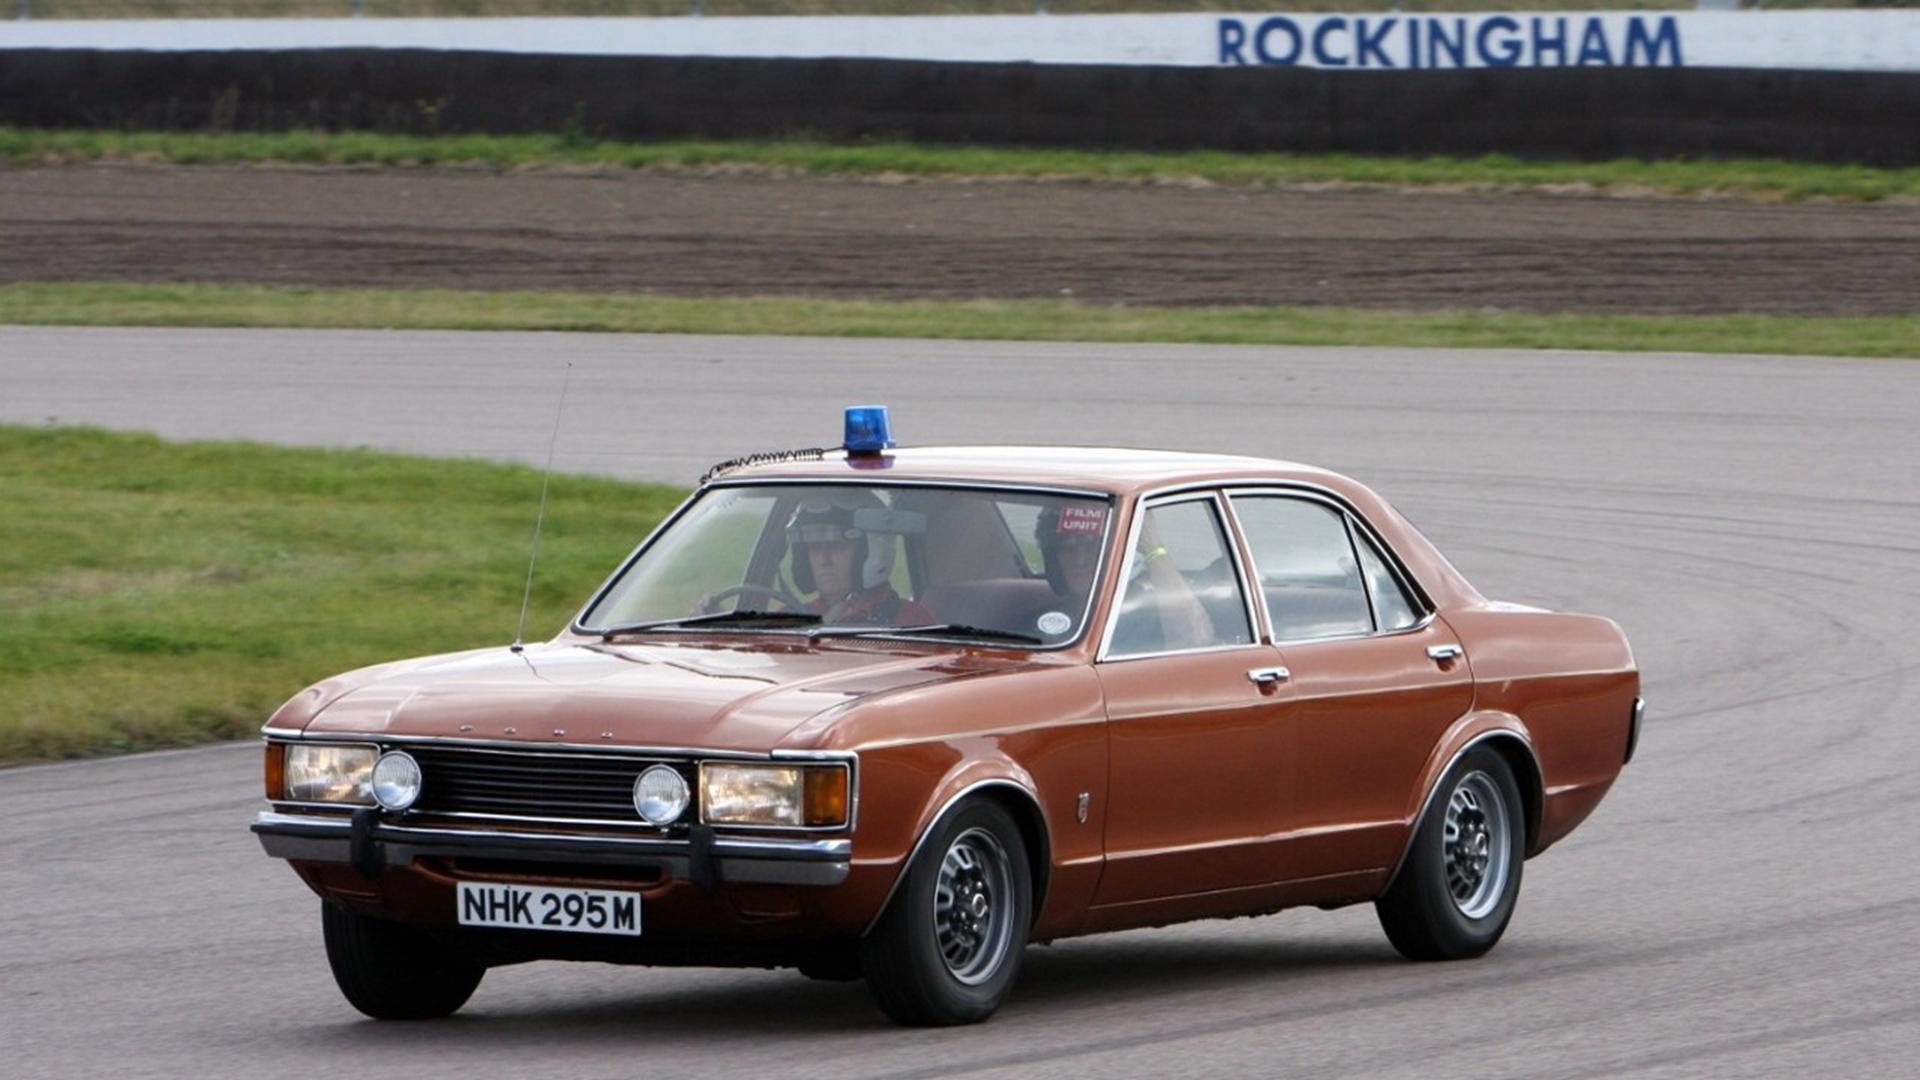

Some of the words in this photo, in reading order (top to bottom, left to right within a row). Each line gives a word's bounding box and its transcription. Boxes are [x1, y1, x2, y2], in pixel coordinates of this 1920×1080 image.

[1218, 16, 1683, 67] ROCKINGHAM
[1065, 507, 1102, 518] FILM
[1063, 520, 1099, 530] UNIT
[463, 887, 534, 925] NHK
